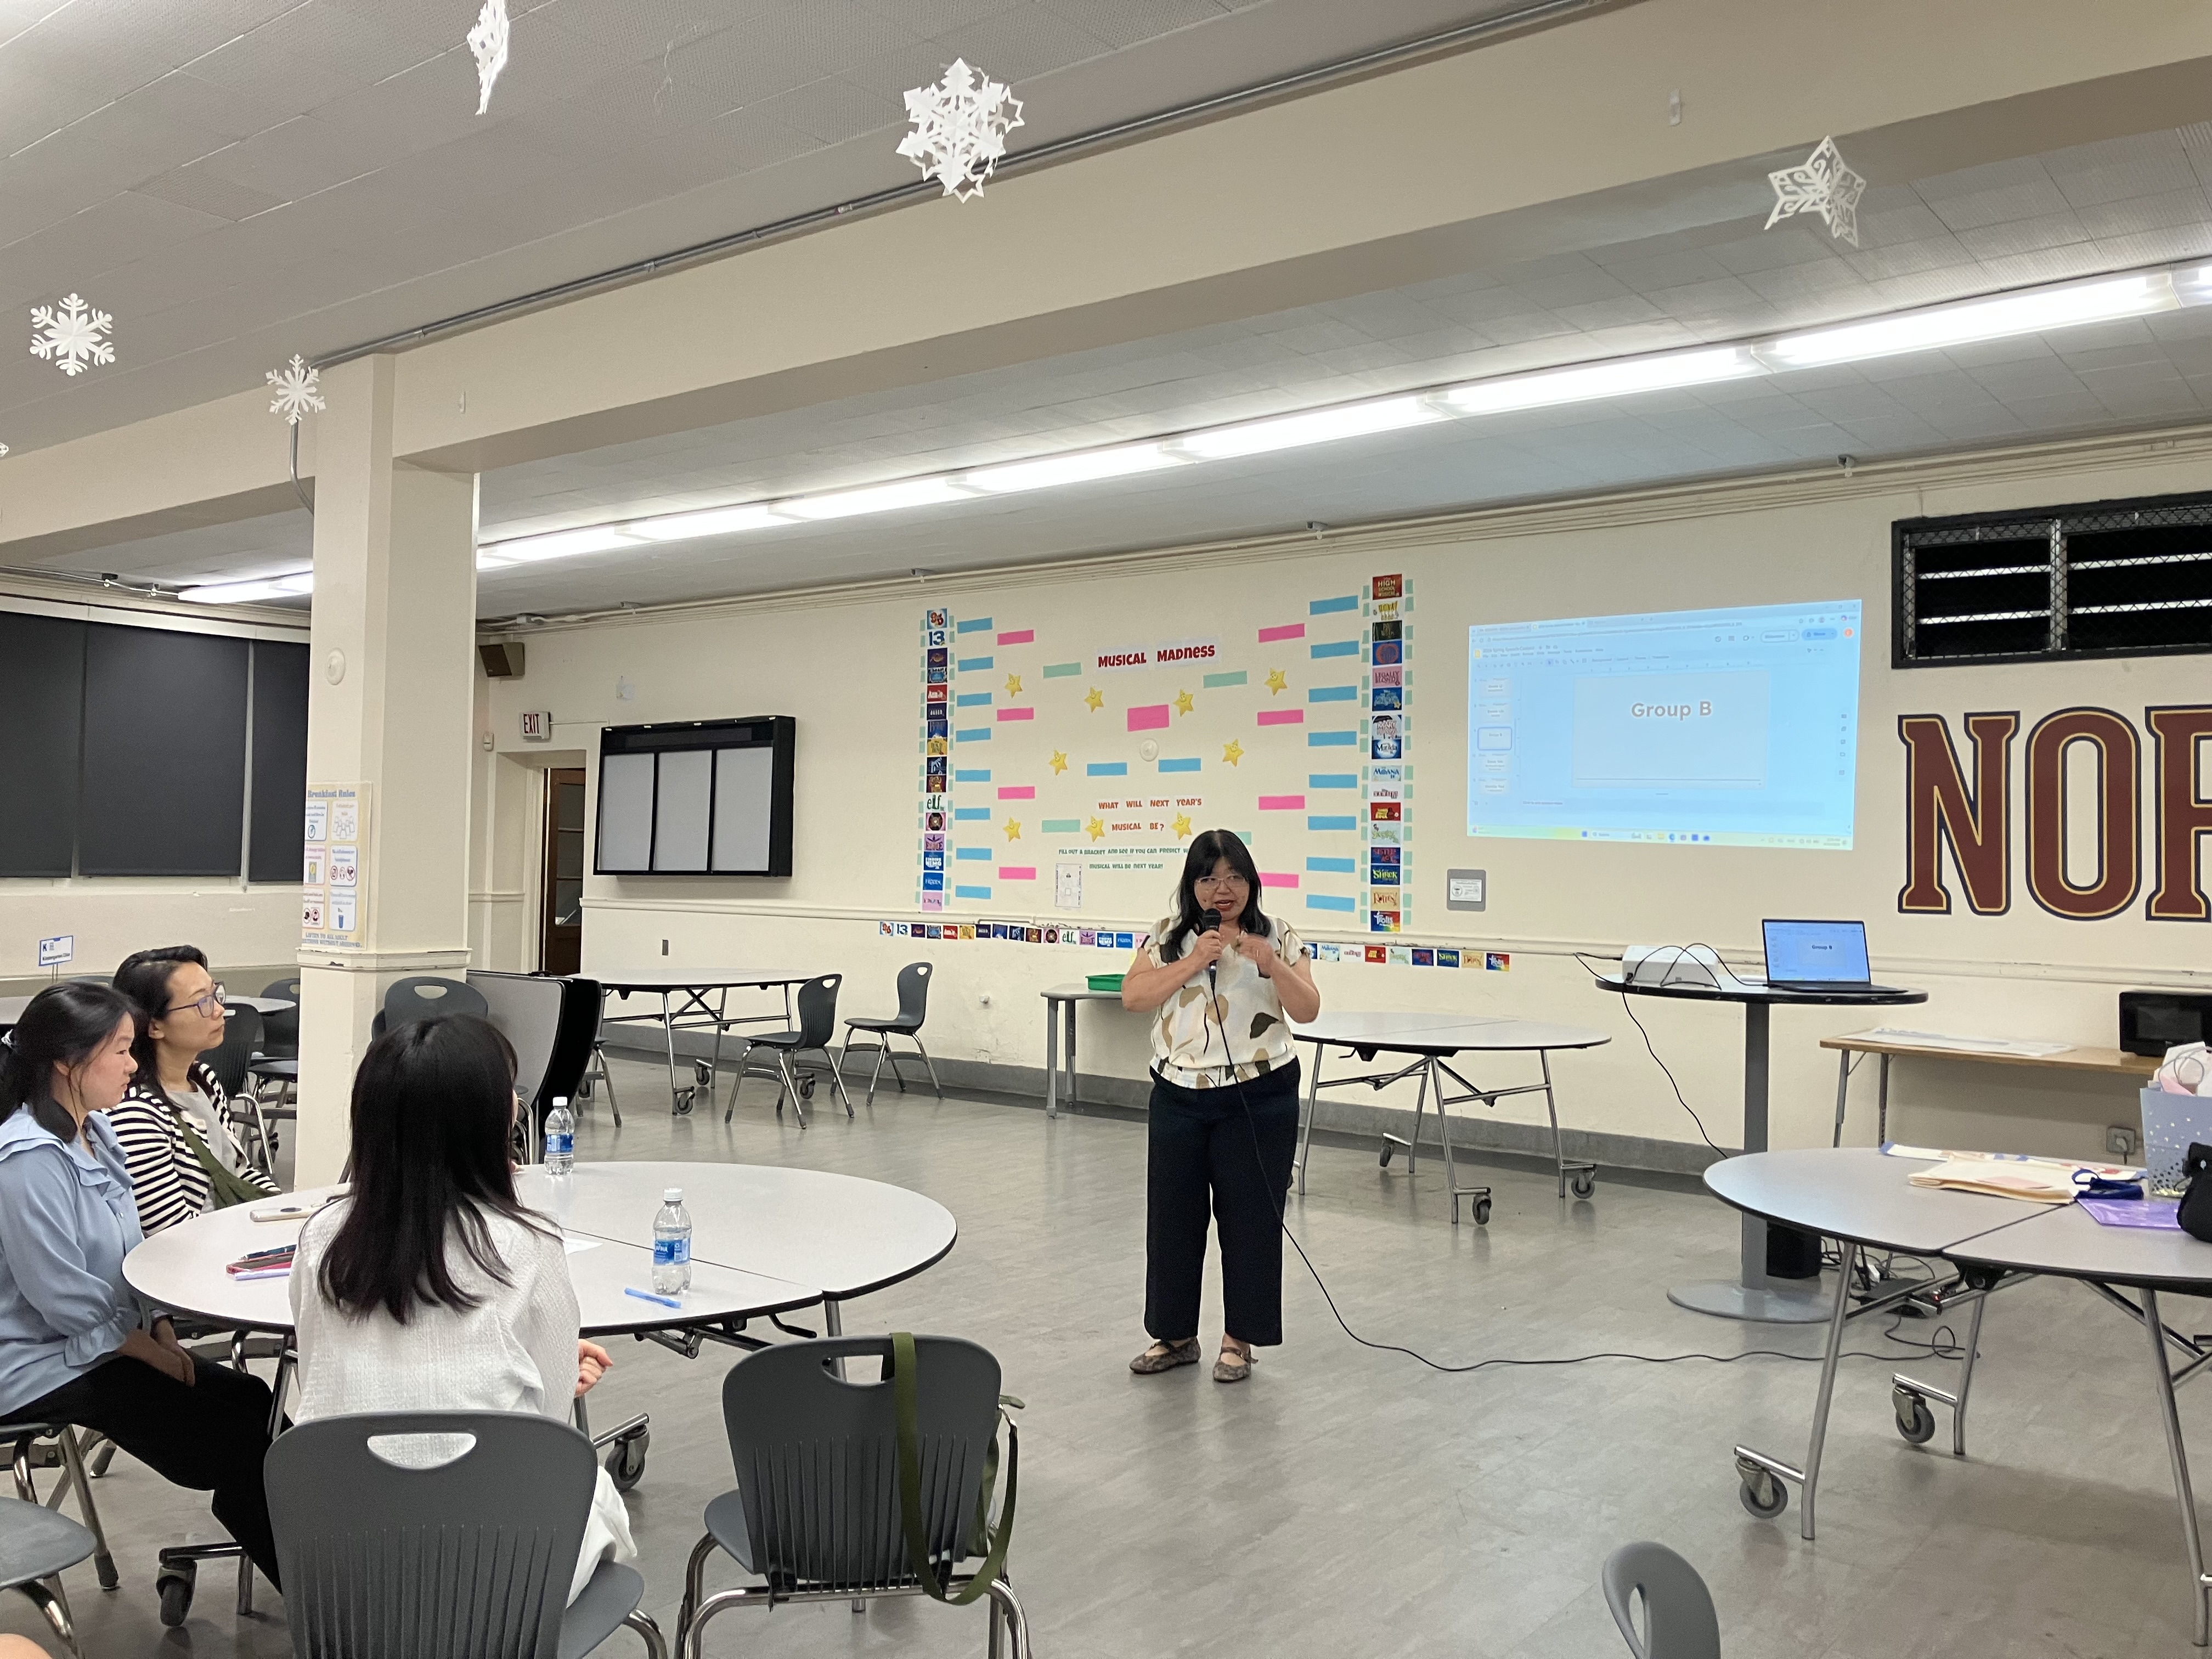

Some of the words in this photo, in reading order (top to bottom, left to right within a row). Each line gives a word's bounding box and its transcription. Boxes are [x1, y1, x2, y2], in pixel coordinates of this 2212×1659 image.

[929, 630, 945, 646] 13
[1098, 652, 1147, 668] MUSICAL
[1632, 703, 1691, 721] Group
[1700, 701, 1712, 716] B
[523, 713, 539, 734] EXIT
[1111, 823, 1142, 831] MUSICAL
[896, 923, 909, 935] 13
[42, 943, 47, 952] K
